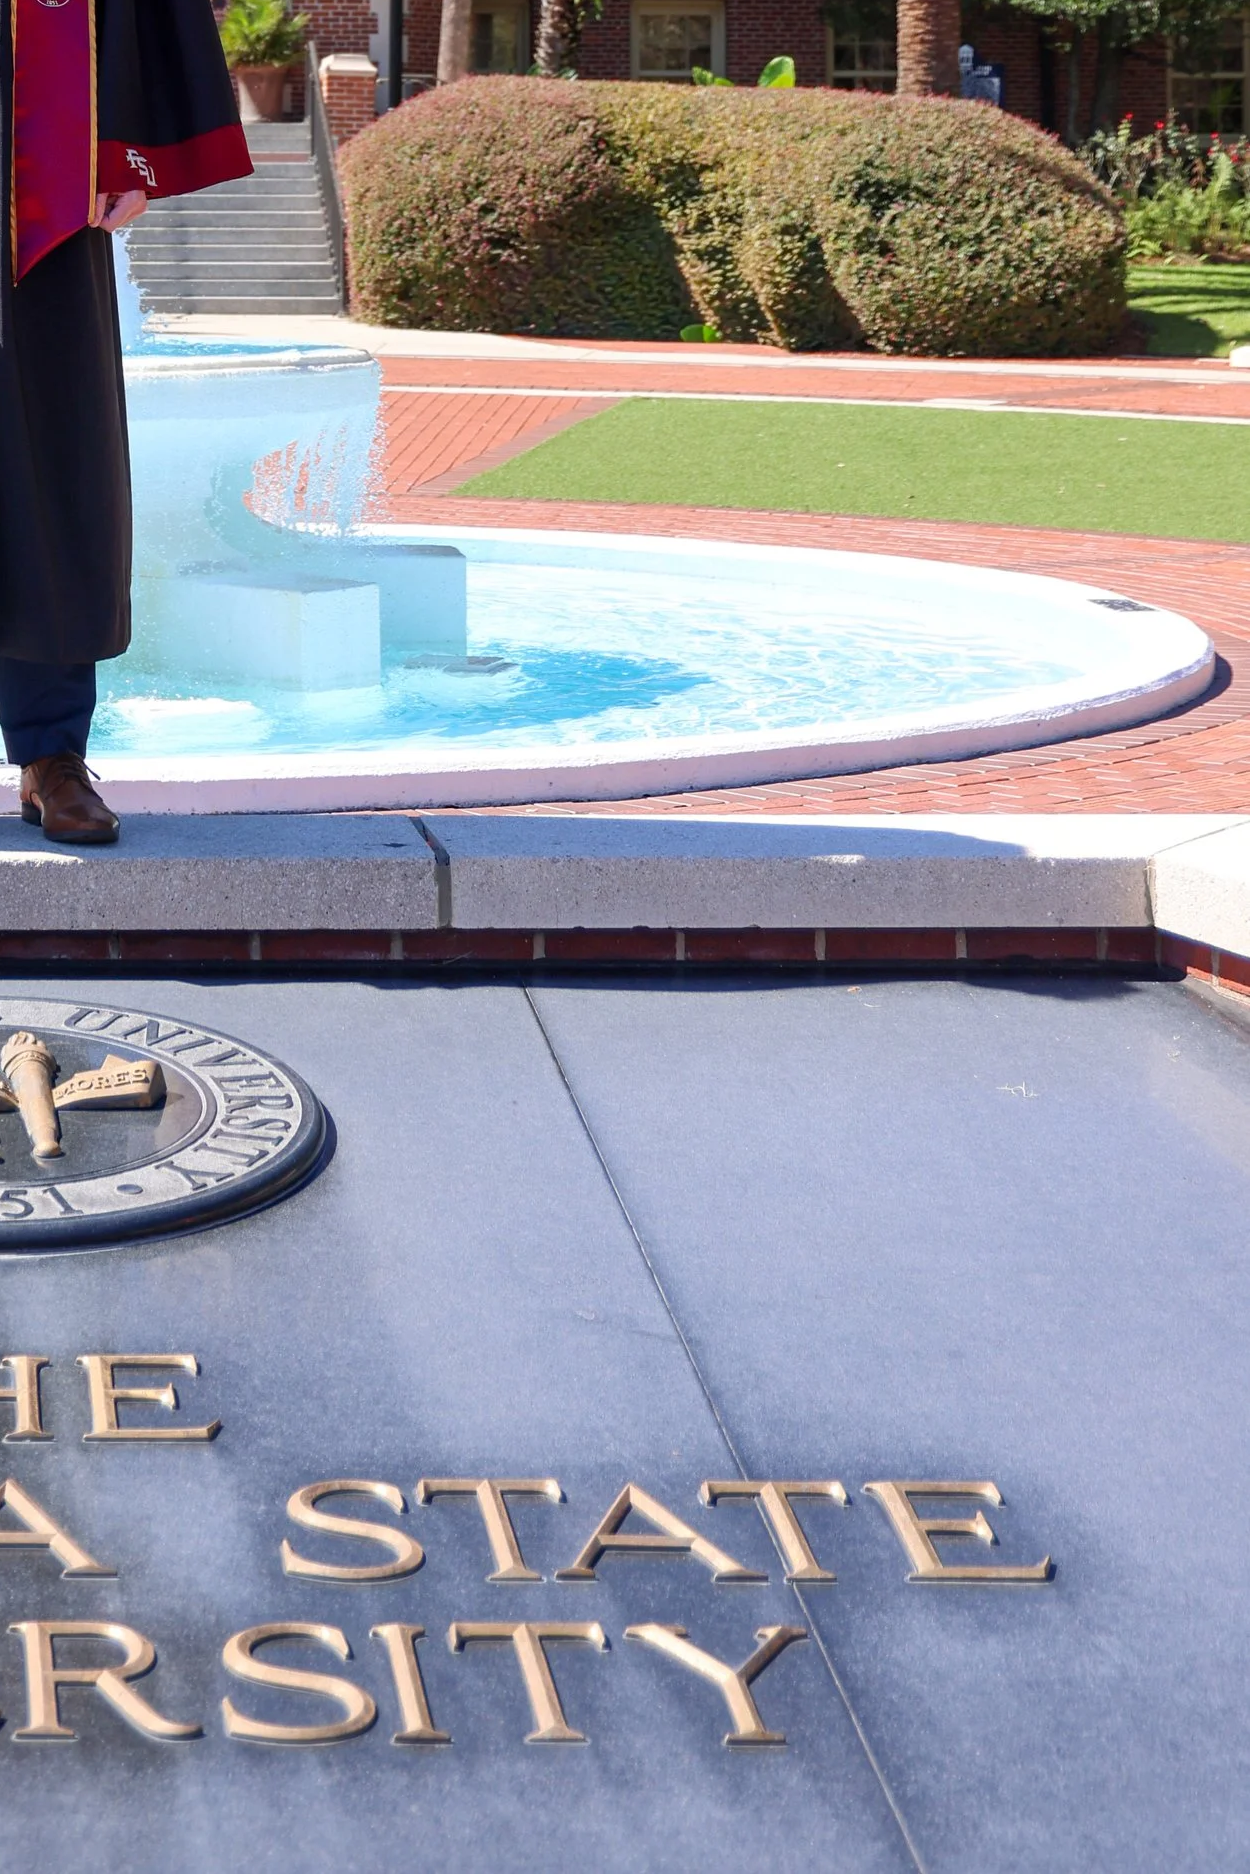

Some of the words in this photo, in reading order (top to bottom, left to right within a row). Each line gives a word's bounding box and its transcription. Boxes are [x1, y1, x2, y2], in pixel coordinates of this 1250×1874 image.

[125, 148, 158, 187] FSU
[63, 1006, 293, 1192] UNIVERSITY
[280, 1478, 1057, 1585] STATE
